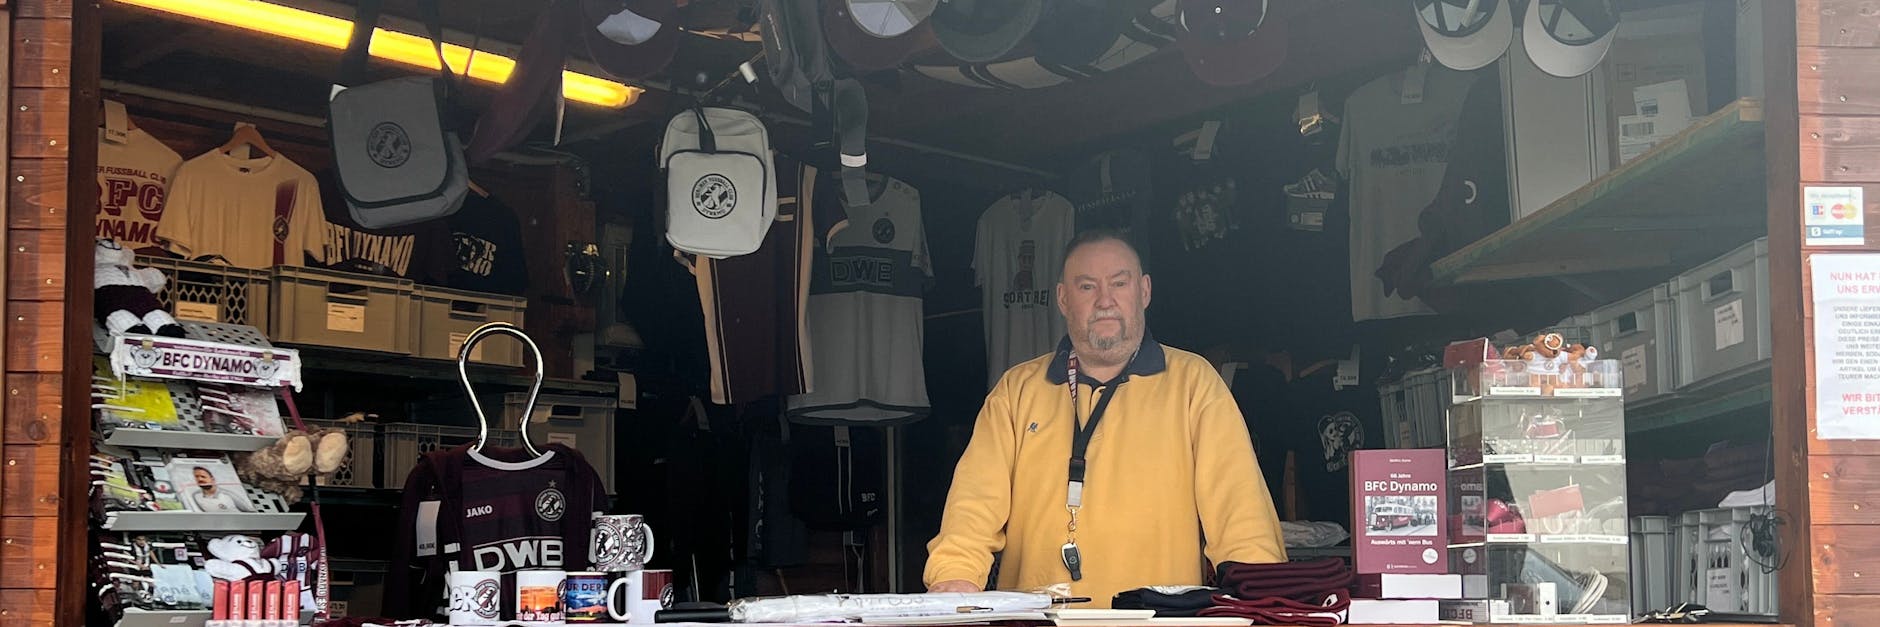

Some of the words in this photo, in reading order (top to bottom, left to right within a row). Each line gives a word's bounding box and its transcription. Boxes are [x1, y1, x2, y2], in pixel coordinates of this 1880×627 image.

[106, 166, 148, 179] FUSSBALL
[96, 219, 166, 246] YNAMO
[352, 230, 416, 277] DYNAMO
[832, 259, 893, 282] DWB
[1830, 271, 1852, 281] NUN
[1855, 271, 1876, 281] HAT
[1837, 284, 1859, 294] UNS
[162, 352, 190, 368] BFC
[193, 354, 252, 374] DYNAMO
[1842, 392, 1863, 402] WIR
[1364, 481, 1388, 491] BFC
[1390, 481, 1438, 493] Dynamo
[466, 504, 493, 518] JAKO
[473, 540, 564, 572] DWB
